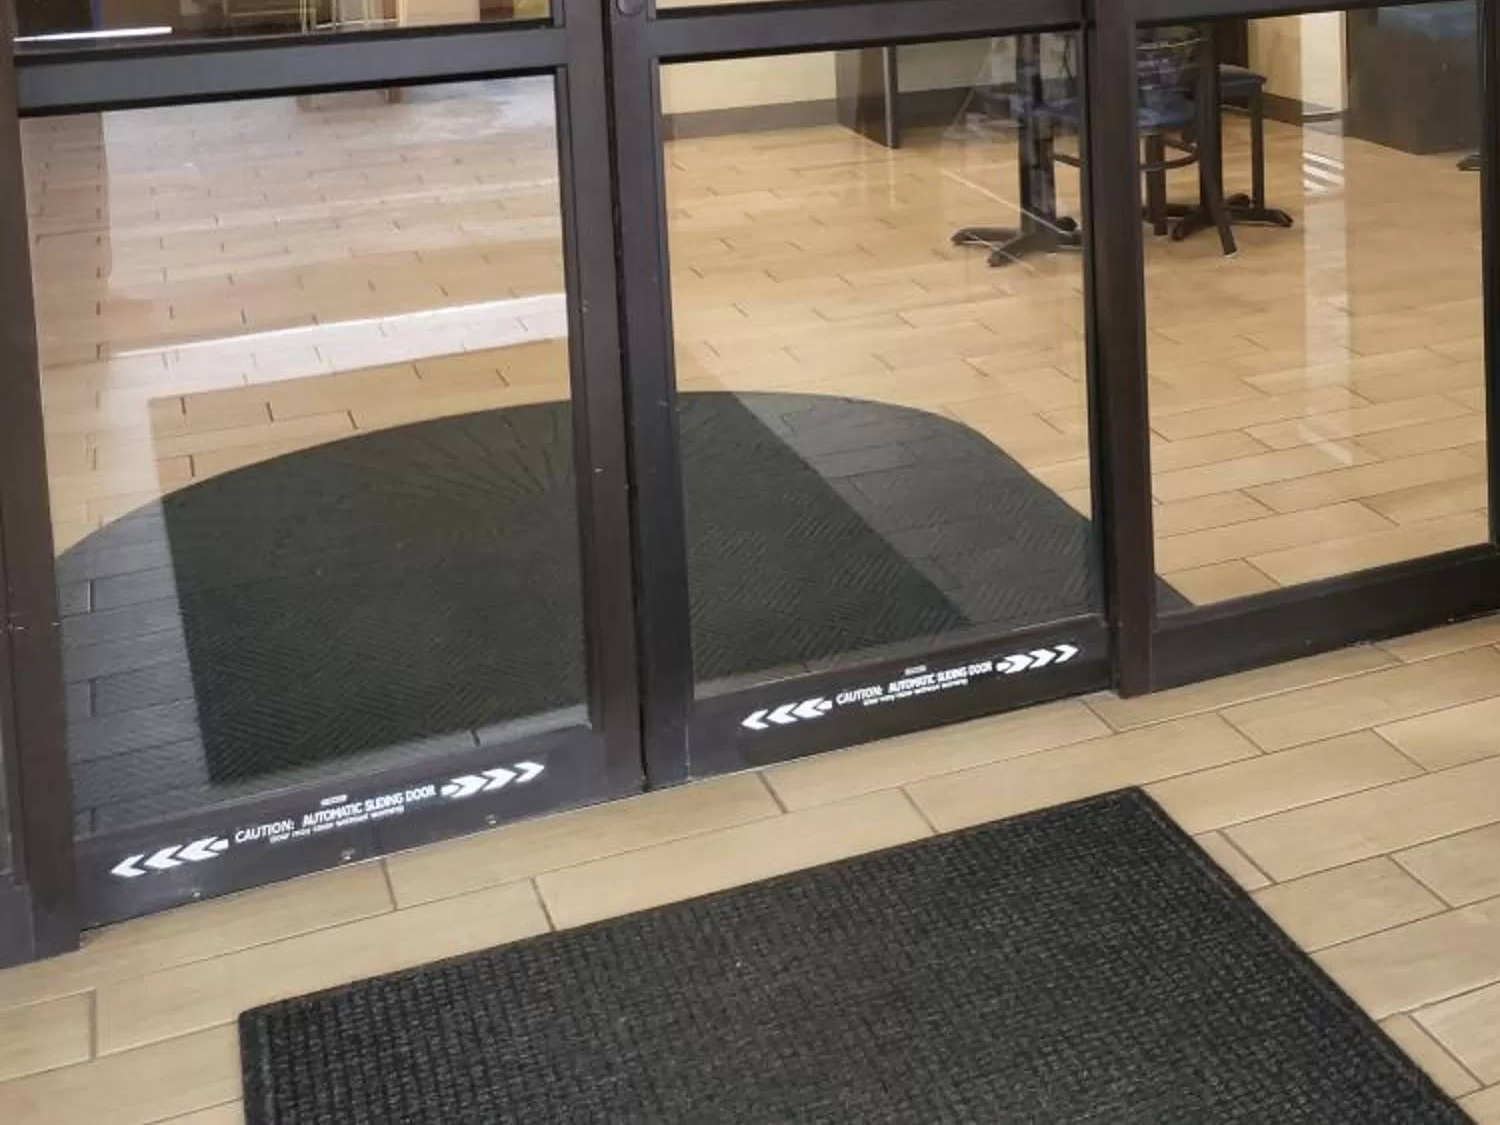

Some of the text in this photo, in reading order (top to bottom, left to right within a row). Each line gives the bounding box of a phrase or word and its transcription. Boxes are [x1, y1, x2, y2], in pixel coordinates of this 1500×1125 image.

[235, 819, 294, 844] CAUTION:
[303, 801, 363, 827] AUTOMATIC
[364, 793, 404, 812] SLIDING
[405, 784, 437, 802] DOOR
